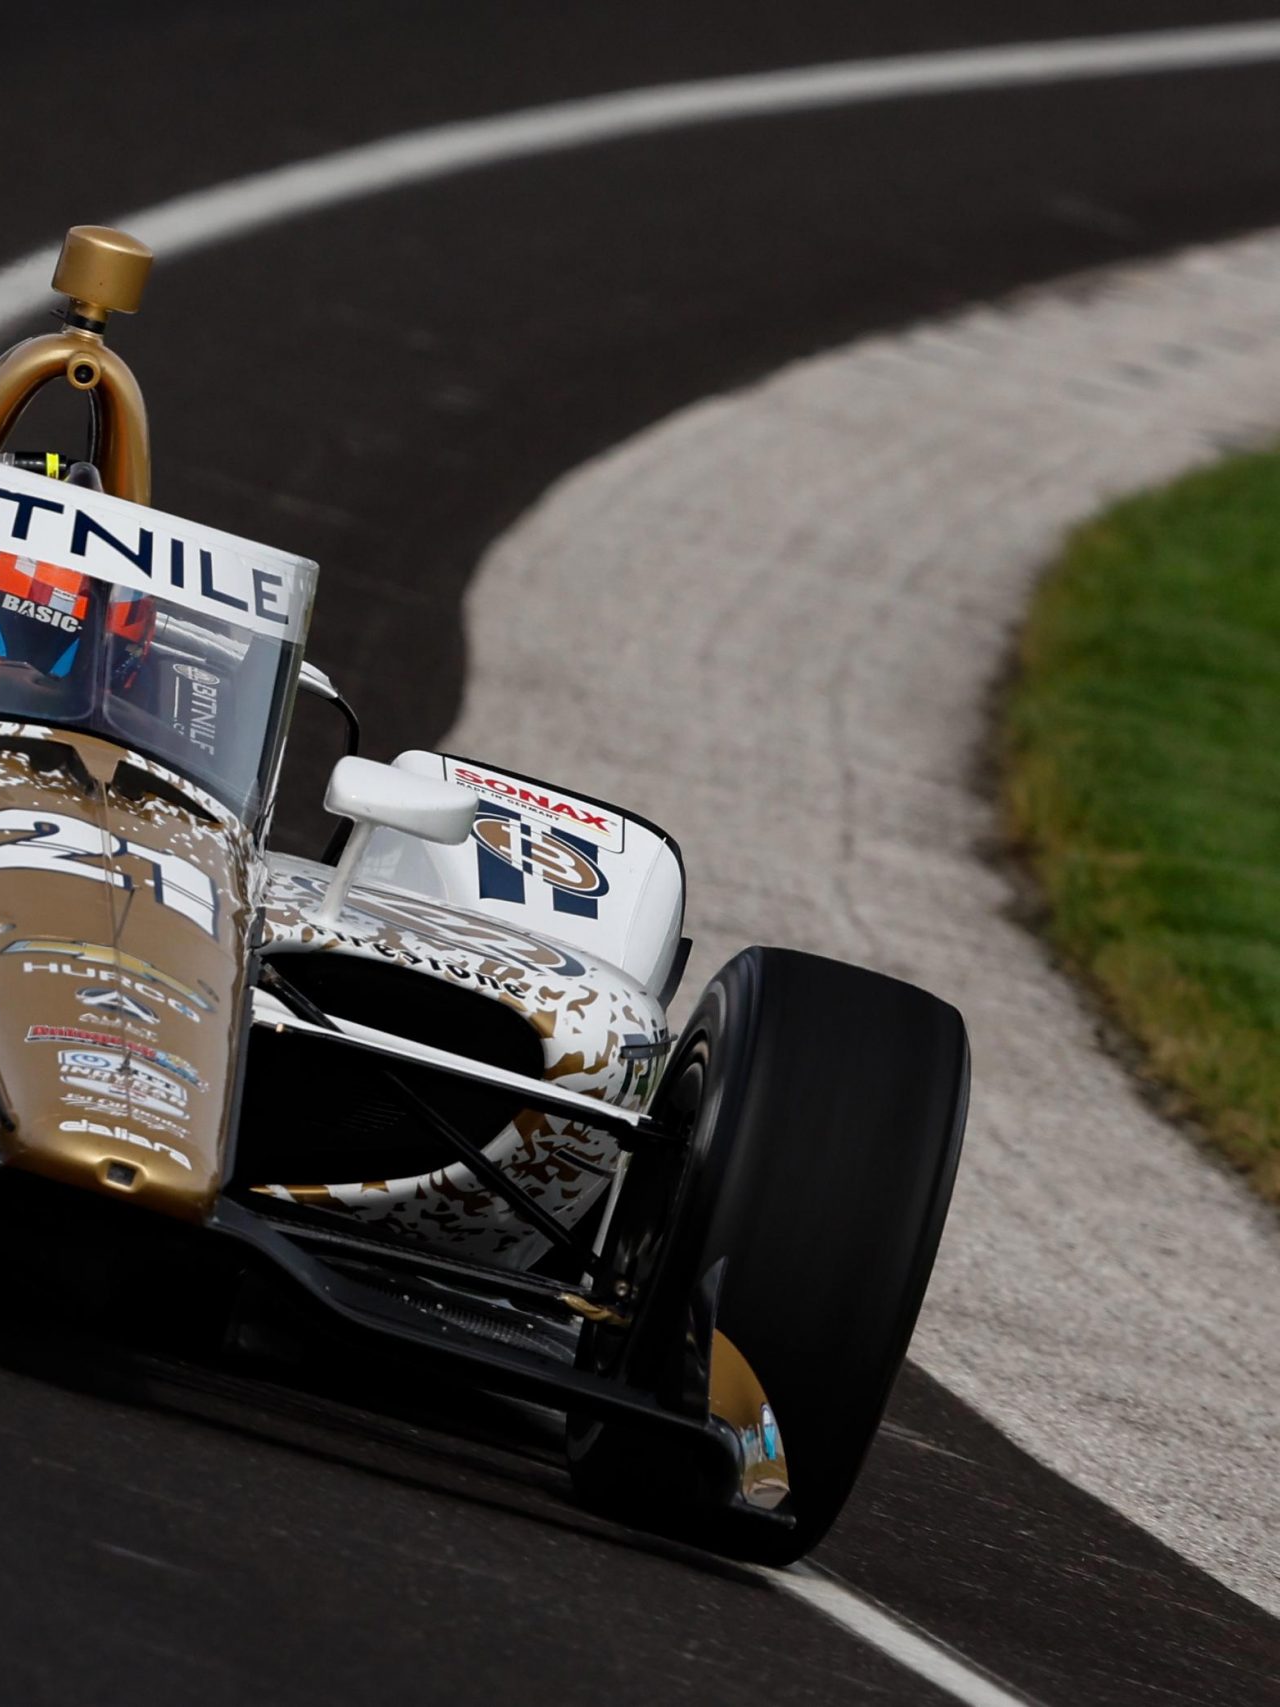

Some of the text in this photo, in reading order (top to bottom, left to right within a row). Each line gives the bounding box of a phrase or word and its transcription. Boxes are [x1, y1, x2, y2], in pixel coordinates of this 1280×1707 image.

[454, 768, 610, 833] SONAX
[456, 781, 487, 794] MADE
[507, 799, 560, 821] GERMANY
[23, 961, 201, 1023] HURCO
[59, 1119, 192, 1170] dallara
